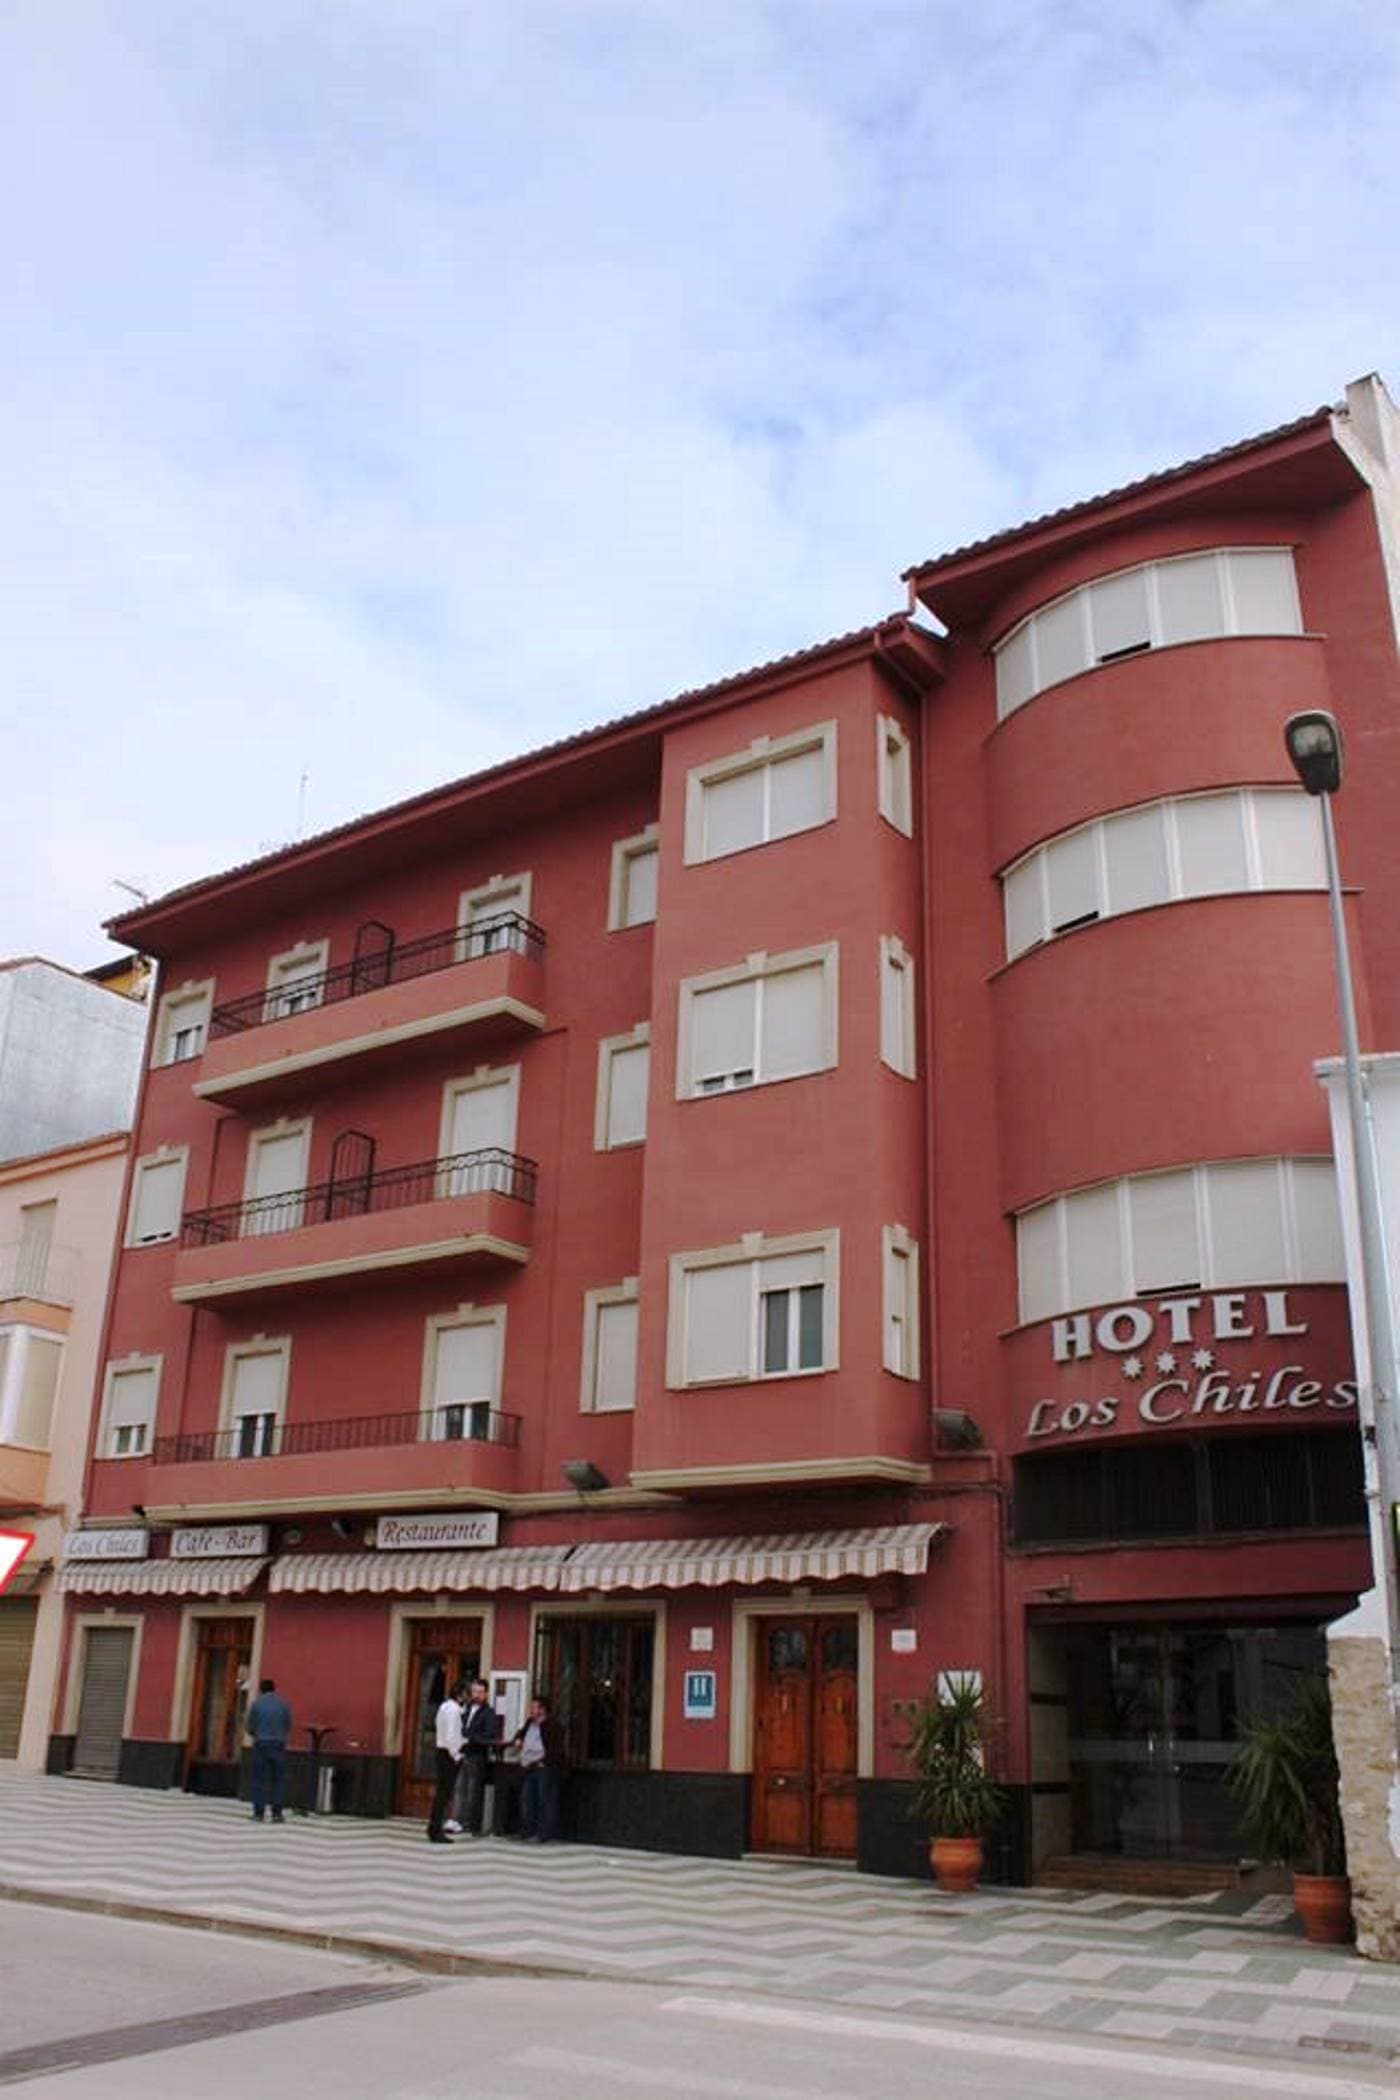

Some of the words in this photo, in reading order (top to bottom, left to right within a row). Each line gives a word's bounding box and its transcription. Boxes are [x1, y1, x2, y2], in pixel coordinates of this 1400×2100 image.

[1052, 1292, 1307, 1362] HOTEL
[1026, 1398, 1119, 1438] Los
[1138, 1366, 1357, 1423] Chiles
[383, 1520, 486, 1543] Restaurante
